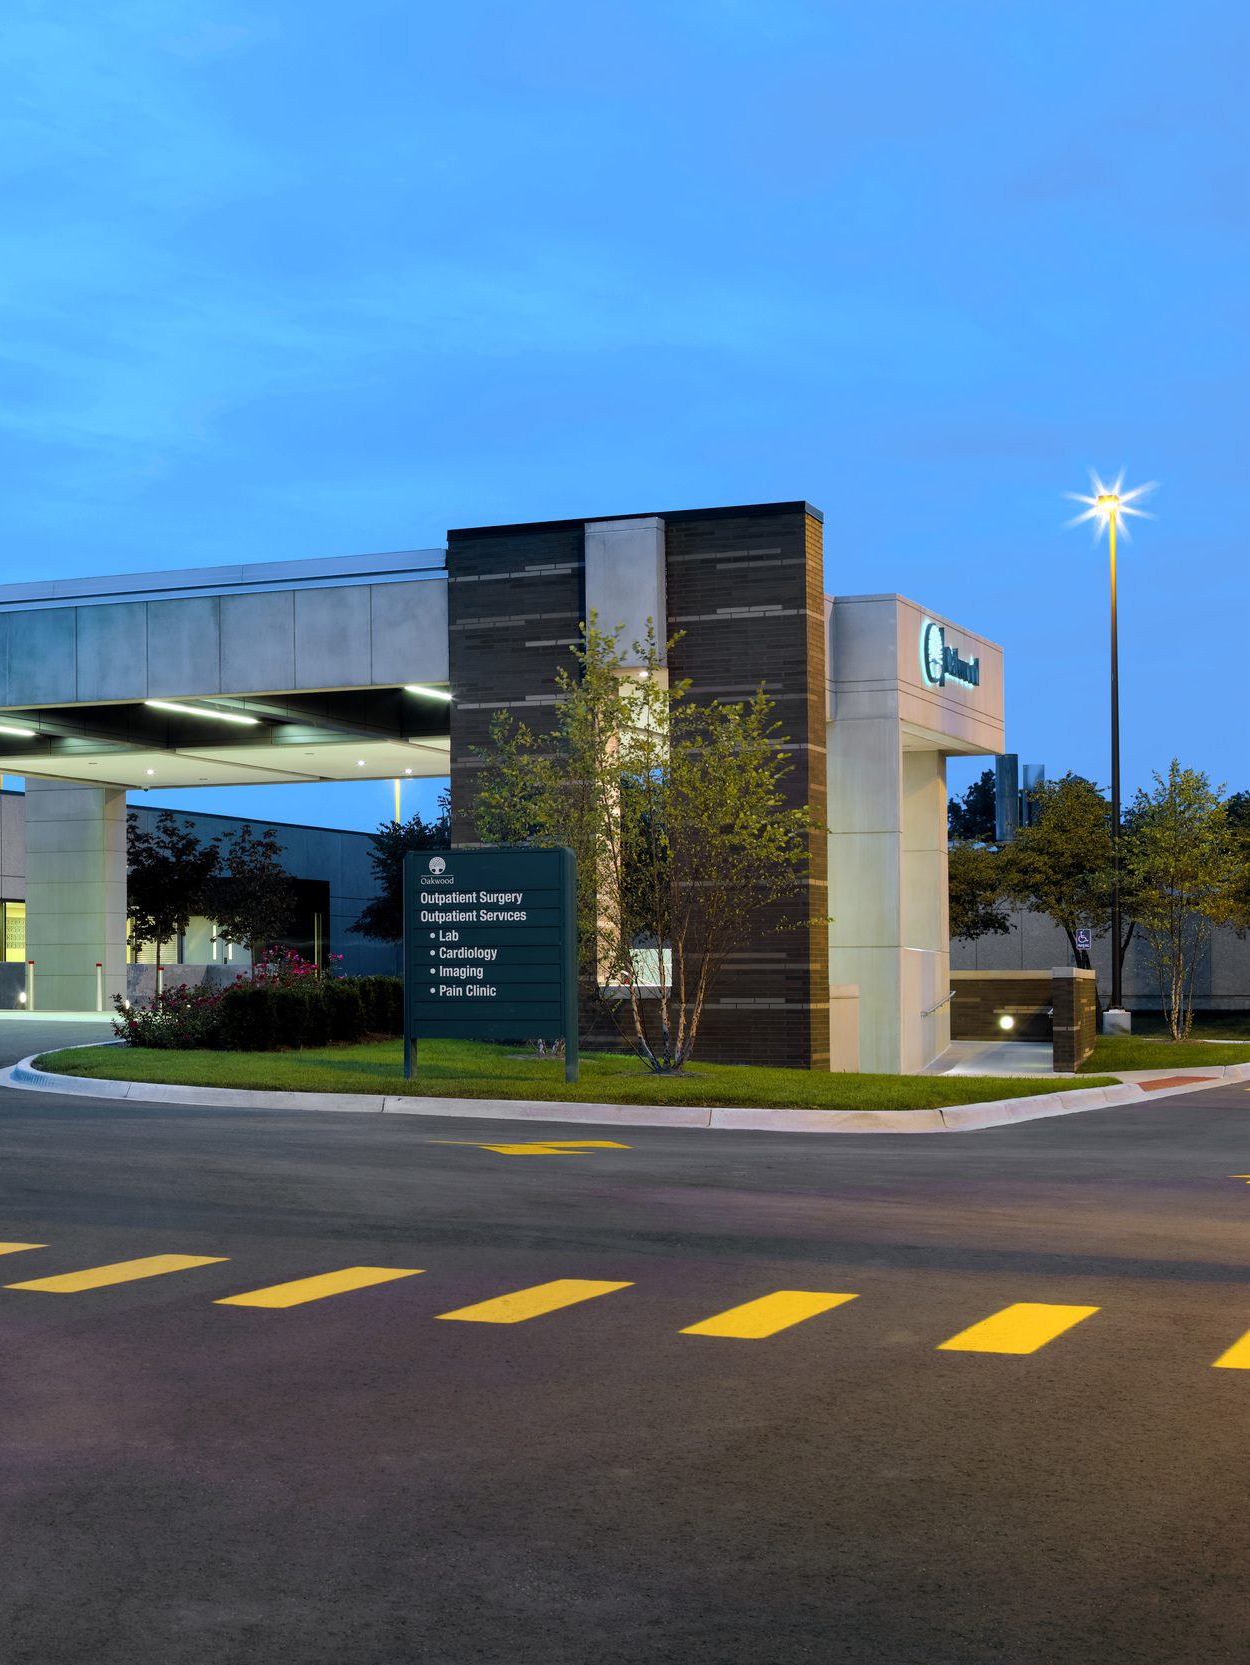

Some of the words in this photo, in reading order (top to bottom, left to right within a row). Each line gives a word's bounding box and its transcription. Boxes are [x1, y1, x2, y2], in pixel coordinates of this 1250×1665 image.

[421, 877, 454, 885] Oakwood
[421, 892, 477, 905] Outpatient
[480, 891, 523, 905] Surgery
[421, 910, 477, 924] Outpatient
[480, 910, 527, 922] Services
[439, 930, 459, 941] Lab
[439, 947, 497, 960] Cardiology
[439, 966, 484, 979] Imaging
[439, 985, 463, 996] Pain
[466, 985, 497, 996] Clinic
